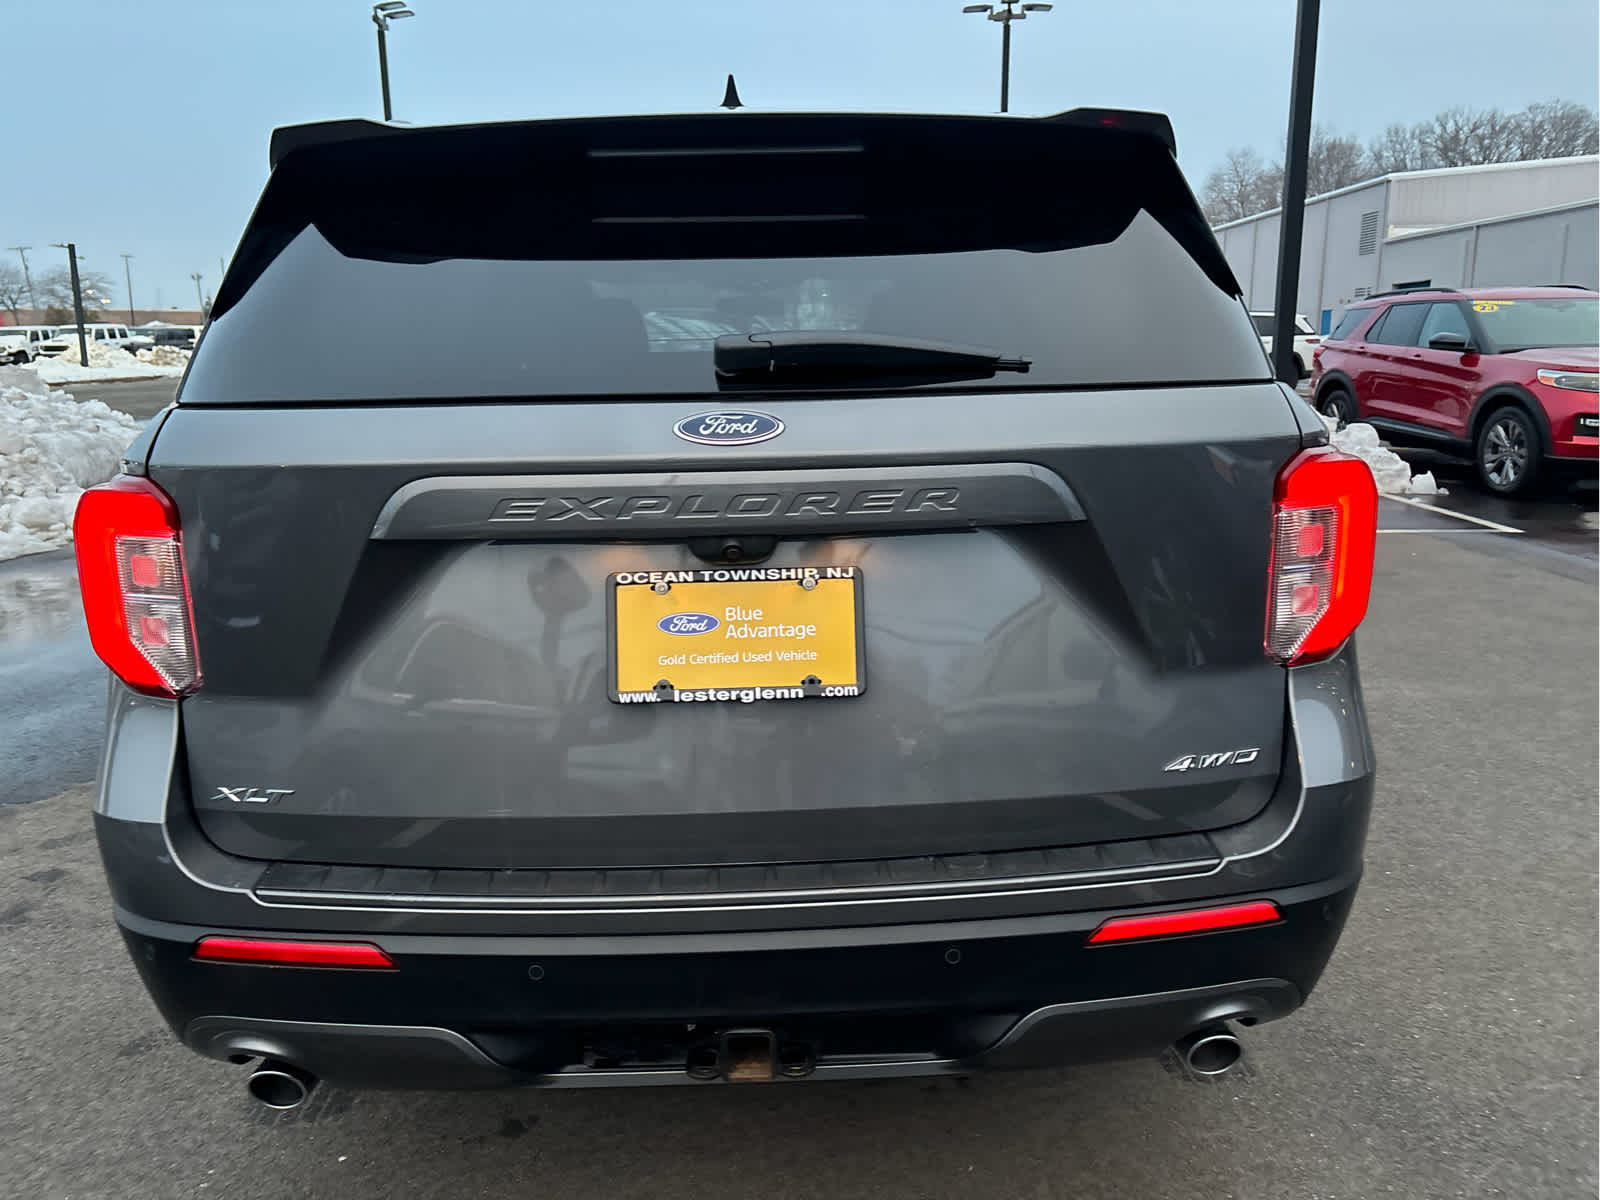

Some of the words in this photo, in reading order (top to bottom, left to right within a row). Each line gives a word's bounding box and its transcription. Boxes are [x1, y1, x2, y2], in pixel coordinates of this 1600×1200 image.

[699, 415, 758, 434] Ford
[488, 487, 960, 522] EXPLORER
[616, 571, 693, 584] OCEAN
[826, 567, 854, 578] NJ
[725, 607, 763, 621] Blue
[669, 616, 708, 632] Ford
[725, 624, 816, 639] Advantage
[658, 655, 686, 665] Gold
[689, 652, 738, 664] Certified
[742, 651, 772, 662] Used
[775, 650, 818, 661] Vehicle
[618, 692, 661, 703] www.
[673, 687, 804, 703] lesterglenn
[820, 685, 858, 697] .com
[1164, 748, 1261, 772] 4WD
[210, 787, 296, 805] XLT
